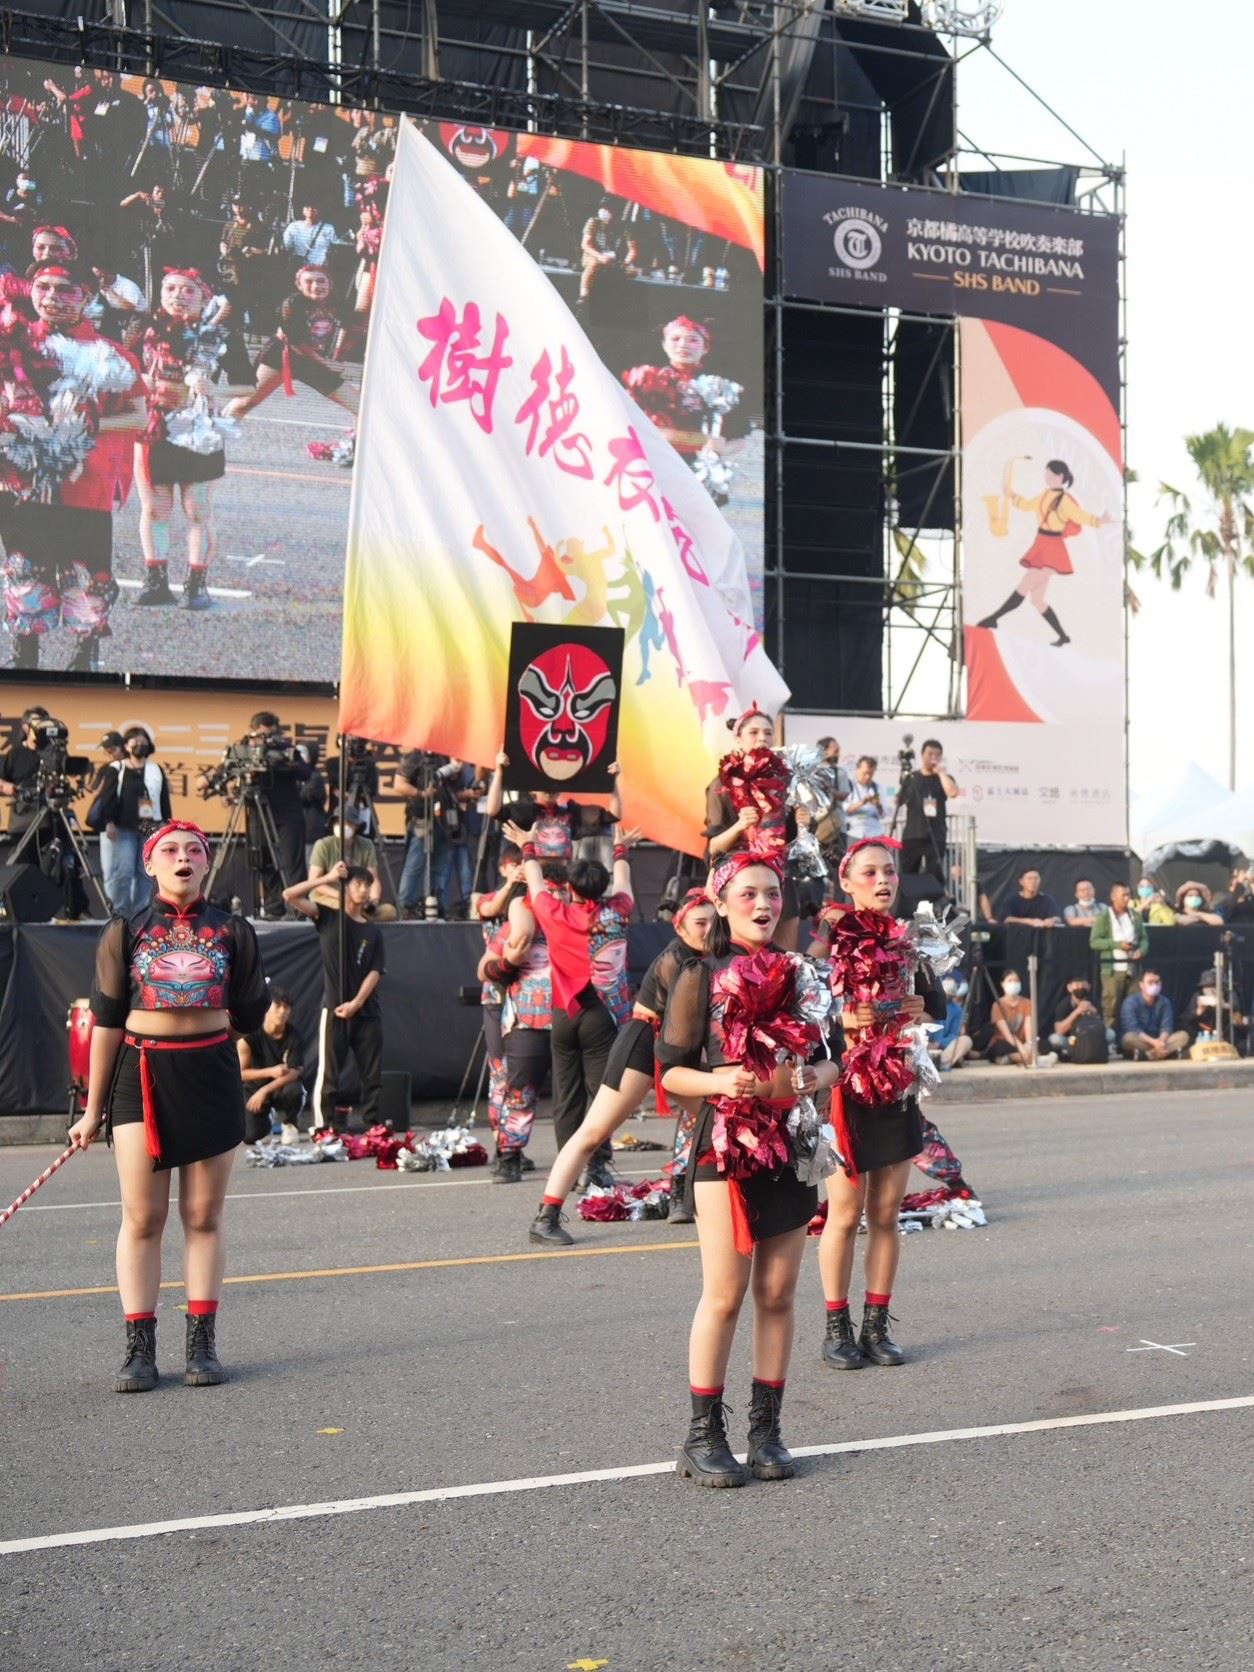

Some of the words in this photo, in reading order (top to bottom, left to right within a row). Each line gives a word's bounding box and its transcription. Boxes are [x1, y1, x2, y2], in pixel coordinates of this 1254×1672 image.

[822, 206, 888, 233] TACHIBANA
[907, 242, 971, 266] KYOTO
[977, 251, 1085, 280] TACHIBANA
[828, 267, 852, 278] SHS
[854, 270, 887, 282] BAND
[953, 271, 988, 289] SHS
[991, 278, 1041, 296] BAND
